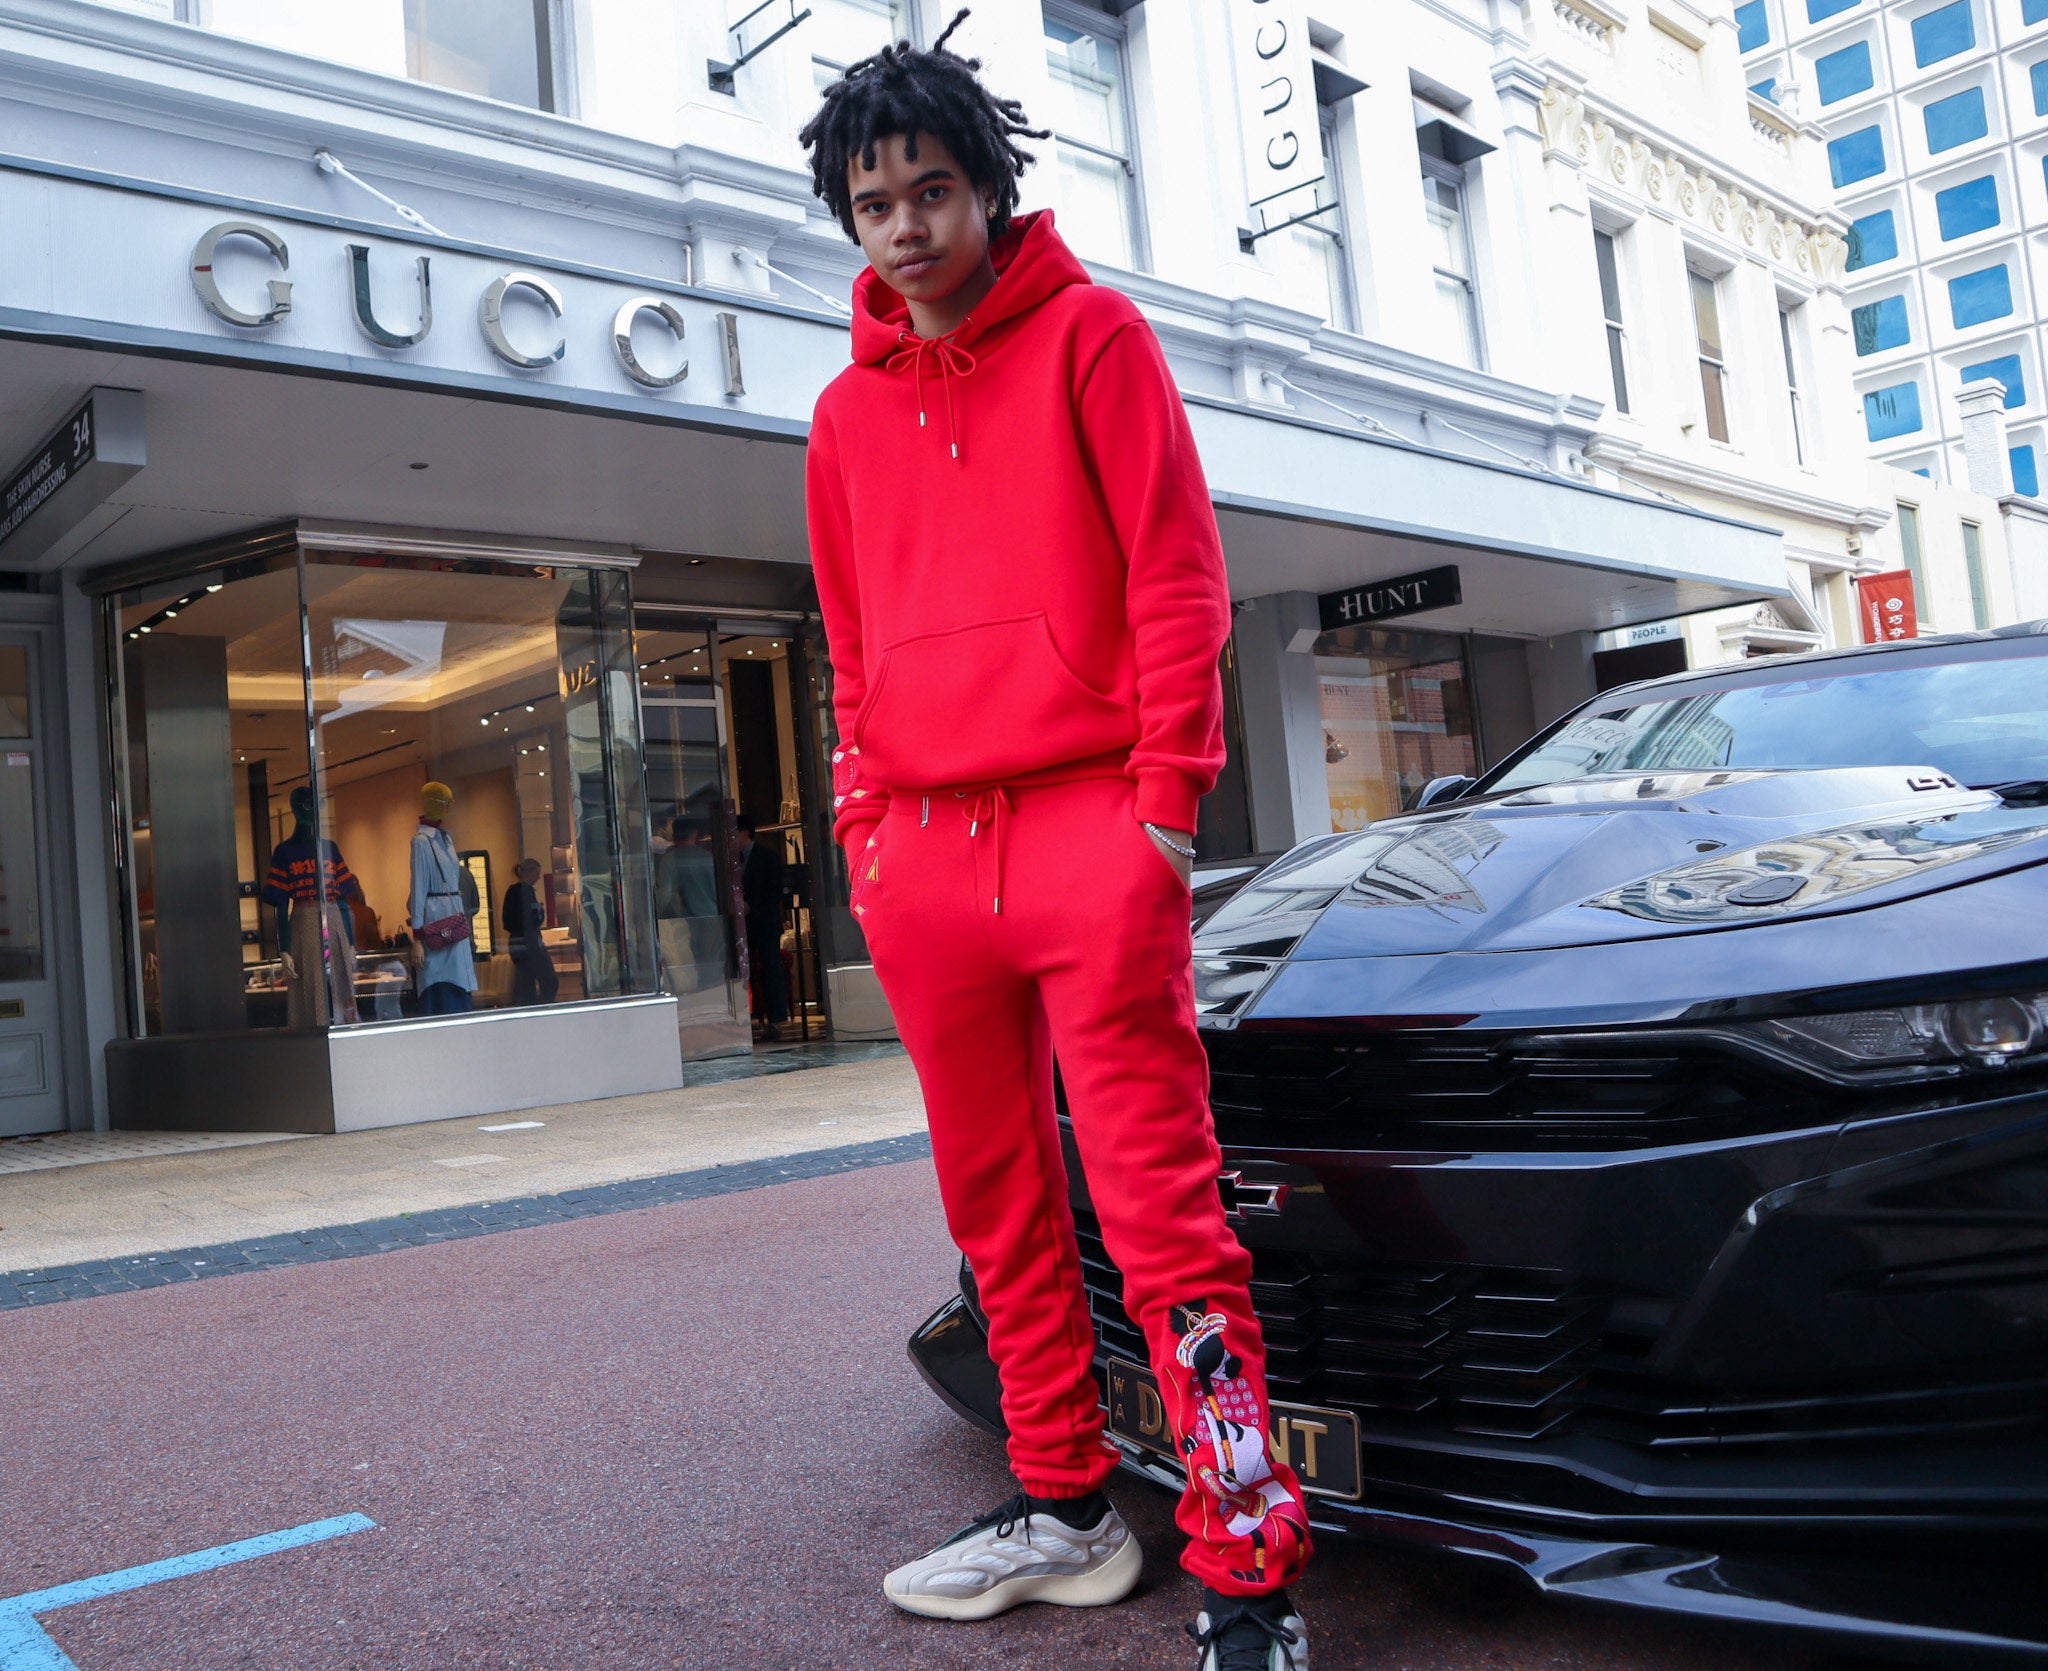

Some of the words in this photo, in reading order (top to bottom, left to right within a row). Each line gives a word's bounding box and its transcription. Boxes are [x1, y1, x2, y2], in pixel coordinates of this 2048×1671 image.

[1253, 0, 1298, 170] GUC
[189, 221, 746, 397] GUCCI
[73, 411, 90, 457] 34
[1339, 580, 1428, 620] HUNT
[1632, 625, 1668, 640] PEOPLE
[1323, 683, 1350, 696] HUNT
